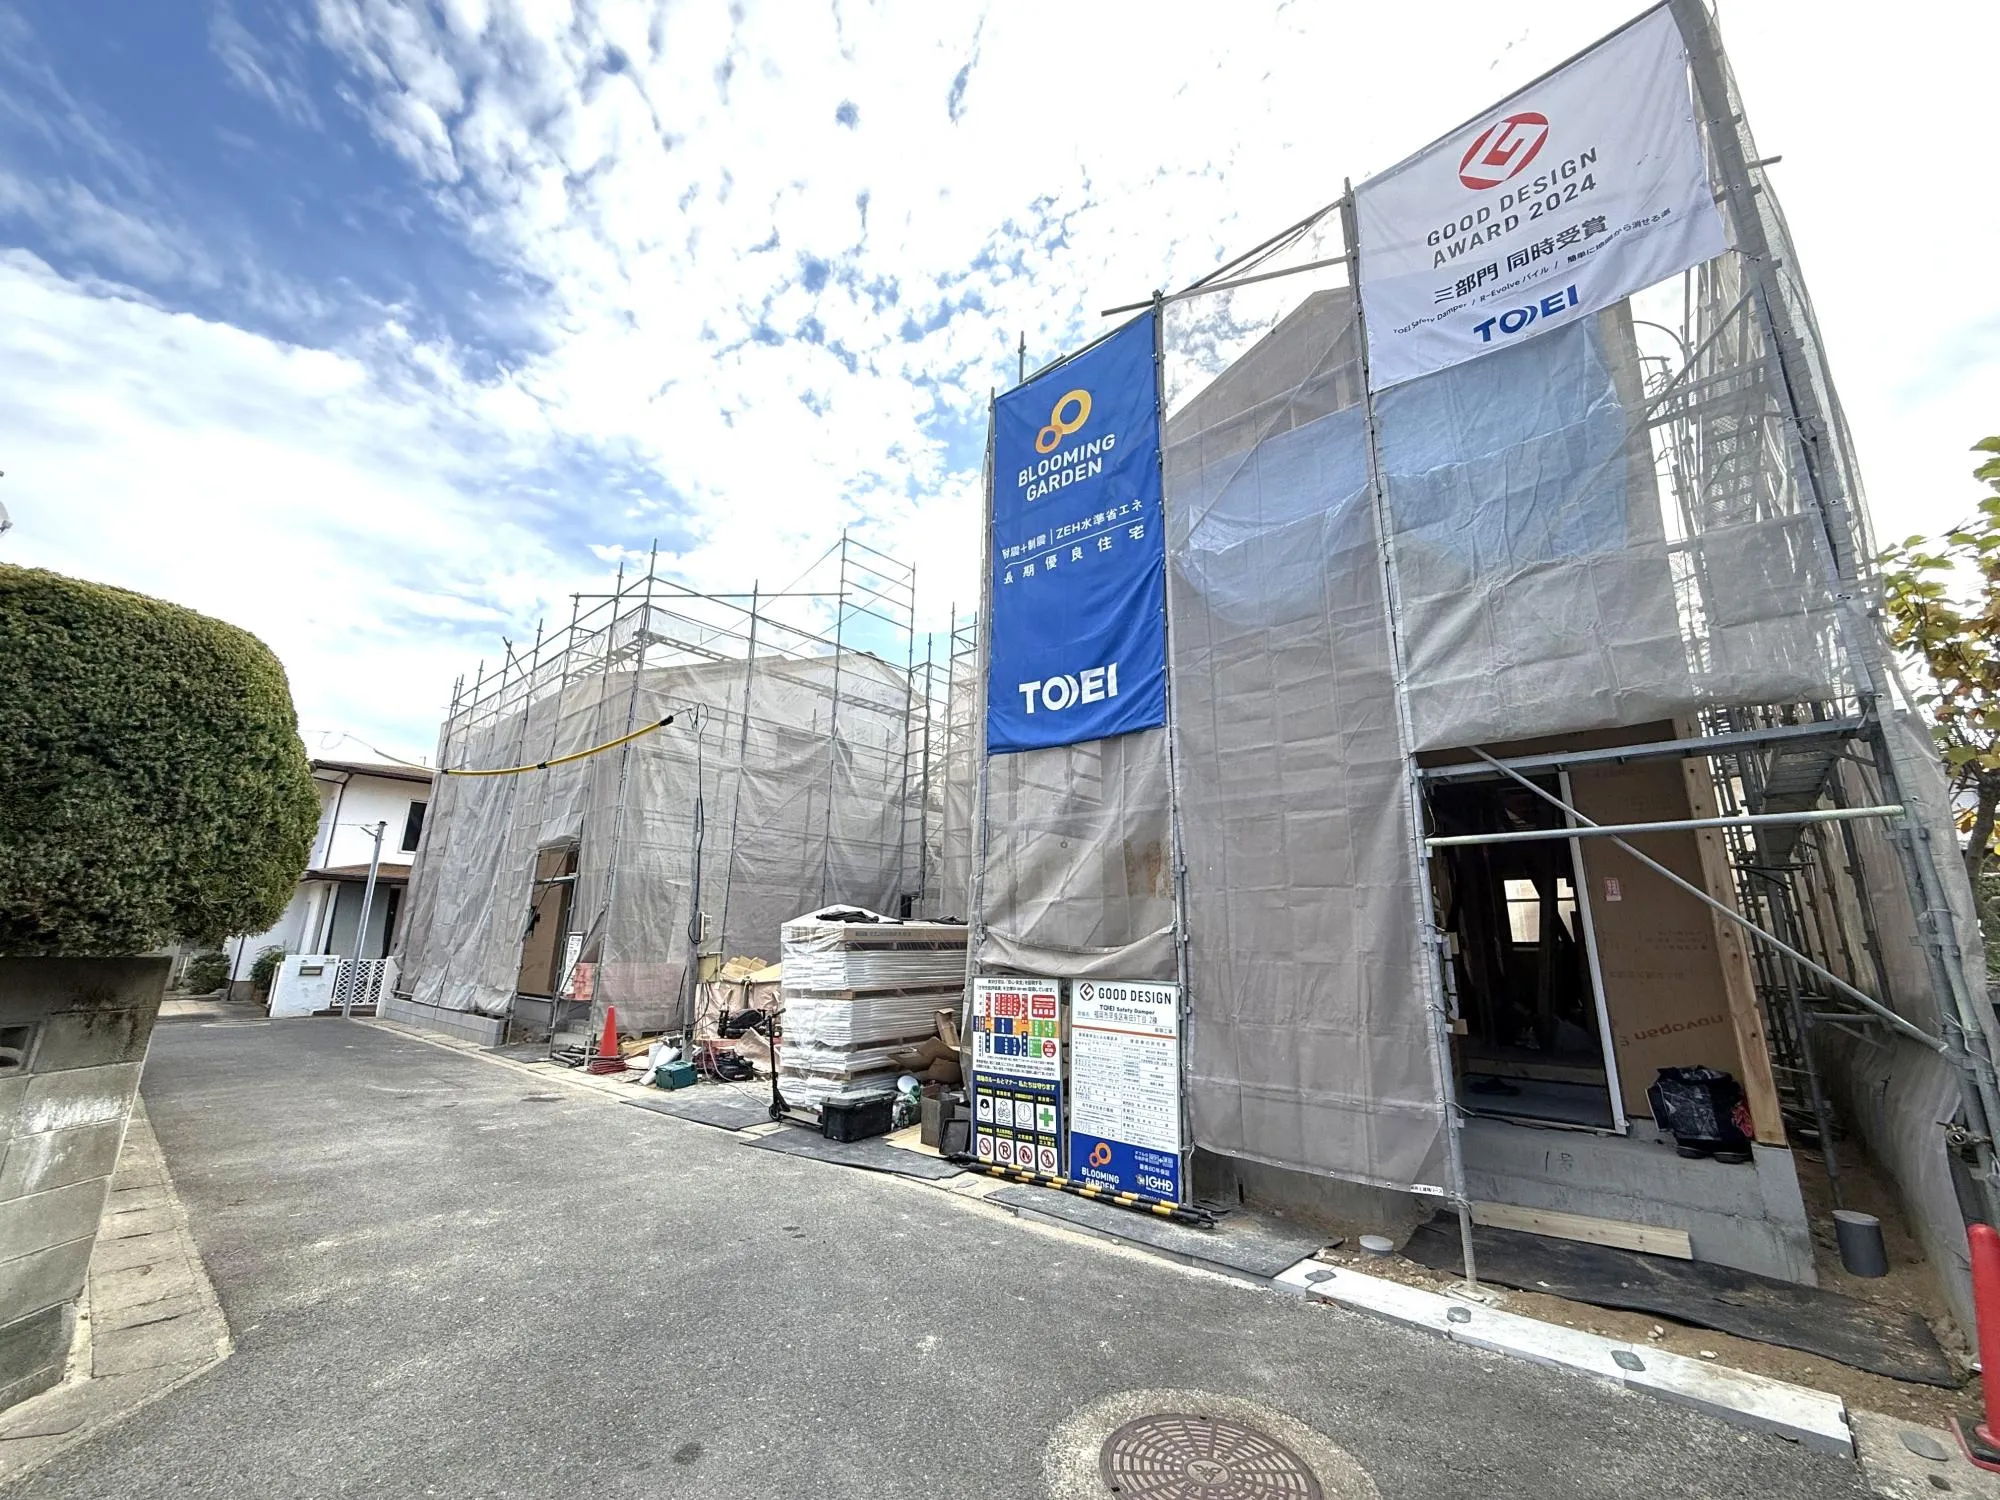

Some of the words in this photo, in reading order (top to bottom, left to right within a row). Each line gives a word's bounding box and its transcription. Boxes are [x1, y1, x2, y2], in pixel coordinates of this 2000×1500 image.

[1426, 206, 1491, 247] GOOD
[1500, 147, 1598, 212] DESIGN
[1432, 218, 1519, 269] AWARD
[1529, 173, 1597, 220] 2024
[1433, 261, 1499, 304] 三部門
[1507, 215, 1608, 273] 同時受賞
[1437, 303, 1468, 321] Damper
[1473, 284, 1579, 343] TOEI
[1018, 433, 1116, 488] BLOOMING
[1026, 458, 1103, 502] GARDEN
[1056, 499, 1143, 540] ZEH水準省エネ
[1003, 524, 1145, 585] 長期優良住宅
[1018, 662, 1118, 714] TOEI
[1098, 987, 1127, 1001] GOOD
[1130, 990, 1172, 1005] DESIGN
[1634, 1014, 1724, 1040] novopan
[1081, 1166, 1120, 1184] BLOOMING
